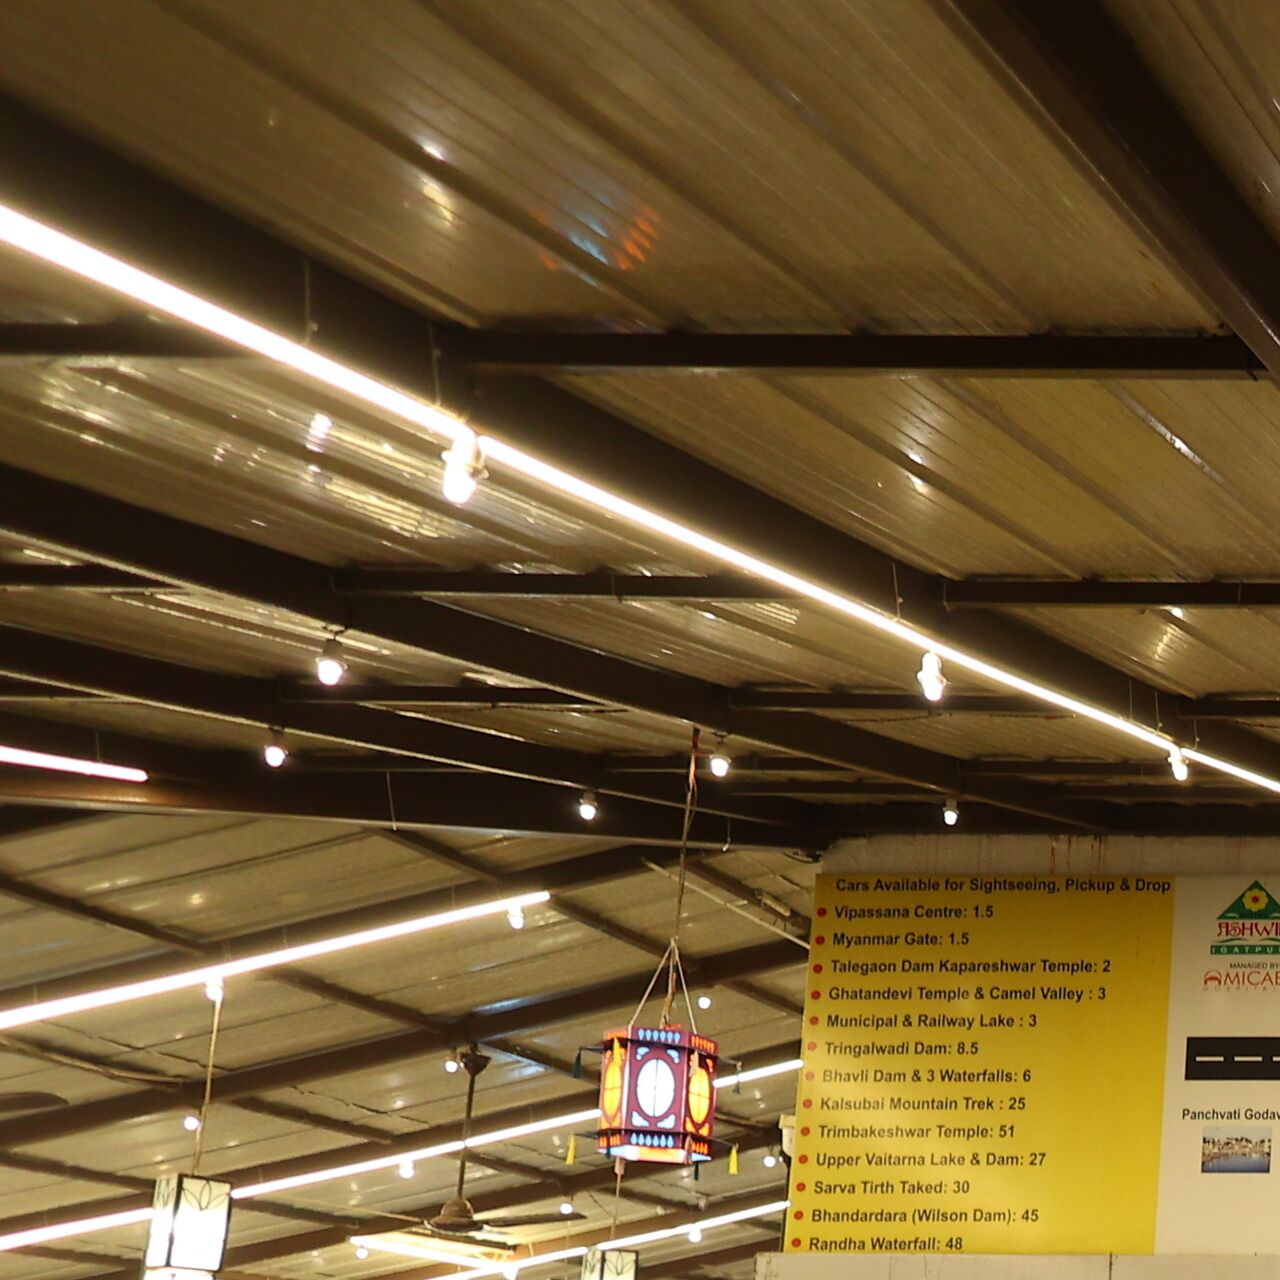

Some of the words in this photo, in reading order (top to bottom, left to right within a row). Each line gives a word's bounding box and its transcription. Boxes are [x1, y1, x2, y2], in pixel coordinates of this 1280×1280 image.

[836, 878, 869, 891] Cars
[873, 878, 940, 891] Available
[945, 878, 965, 891] for
[970, 877, 1060, 894] Sightseeing,
[1065, 878, 1115, 893] Pickup
[1120, 877, 1130, 891] &
[1135, 878, 1170, 894] Drop
[835, 906, 909, 921] Vipassana
[914, 905, 967, 918] Centre:
[974, 905, 993, 918] 1.5
[833, 933, 900, 948] Myanmar
[905, 932, 942, 945] Gate:
[949, 932, 969, 945] 1.5
[832, 960, 896, 976] Talegaon
[902, 959, 934, 972] Dam
[939, 960, 1036, 975] Kapareshwar
[1041, 959, 1097, 975] Temple:
[1103, 960, 1110, 972] 2
[829, 987, 912, 1000] Ghatandevi
[917, 987, 969, 1002] Temple
[975, 987, 984, 999] &
[990, 987, 1035, 999] Camel
[1041, 987, 1083, 1003] Valley
[1098, 987, 1105, 1000] 3
[827, 1014, 897, 1030] Municipal
[902, 1014, 912, 1027] &
[918, 1014, 974, 1030] Railway
[980, 1014, 1014, 1027] Lake
[1029, 1014, 1036, 1027] 3
[826, 1041, 909, 1058] Tringalwadi
[915, 1042, 951, 1054] Dam:
[957, 1042, 978, 1055] 8.5
[823, 1069, 868, 1082] Bhavli
[874, 1070, 906, 1082] Dam
[912, 1069, 921, 1082] &
[927, 1069, 935, 1082] 3
[940, 1069, 1017, 1082] Waterfalls:
[1023, 1069, 1031, 1082] 6
[820, 1098, 884, 1110] Kalsubai
[890, 1097, 957, 1110] Mountain
[963, 1097, 994, 1110] Trek
[1009, 1097, 1025, 1110] 25
[1182, 1109, 1240, 1120] Panchvati
[818, 1125, 931, 1138] Trimbakeshwar
[936, 1125, 993, 1140] Temple:
[999, 1125, 1014, 1138] 51
[817, 1153, 861, 1169] Upper
[866, 1153, 924, 1166] Vaitarna
[931, 1153, 965, 1165] Lake
[970, 1153, 980, 1165] &
[986, 1153, 1024, 1165] Dam:
[1029, 1153, 1046, 1165] 27
[814, 1181, 855, 1194] Sarva
[861, 1181, 894, 1194] Tirth
[900, 1181, 947, 1194] Taked:
[953, 1181, 969, 1193] 30
[812, 1209, 907, 1222] Bhandardara
[912, 1209, 967, 1224] (Wilson
[973, 1209, 1016, 1224] Dam):
[1022, 1209, 1038, 1222] 45
[809, 1237, 865, 1252] Randha
[871, 1237, 940, 1250] Waterfall:
[945, 1237, 963, 1253] 48
